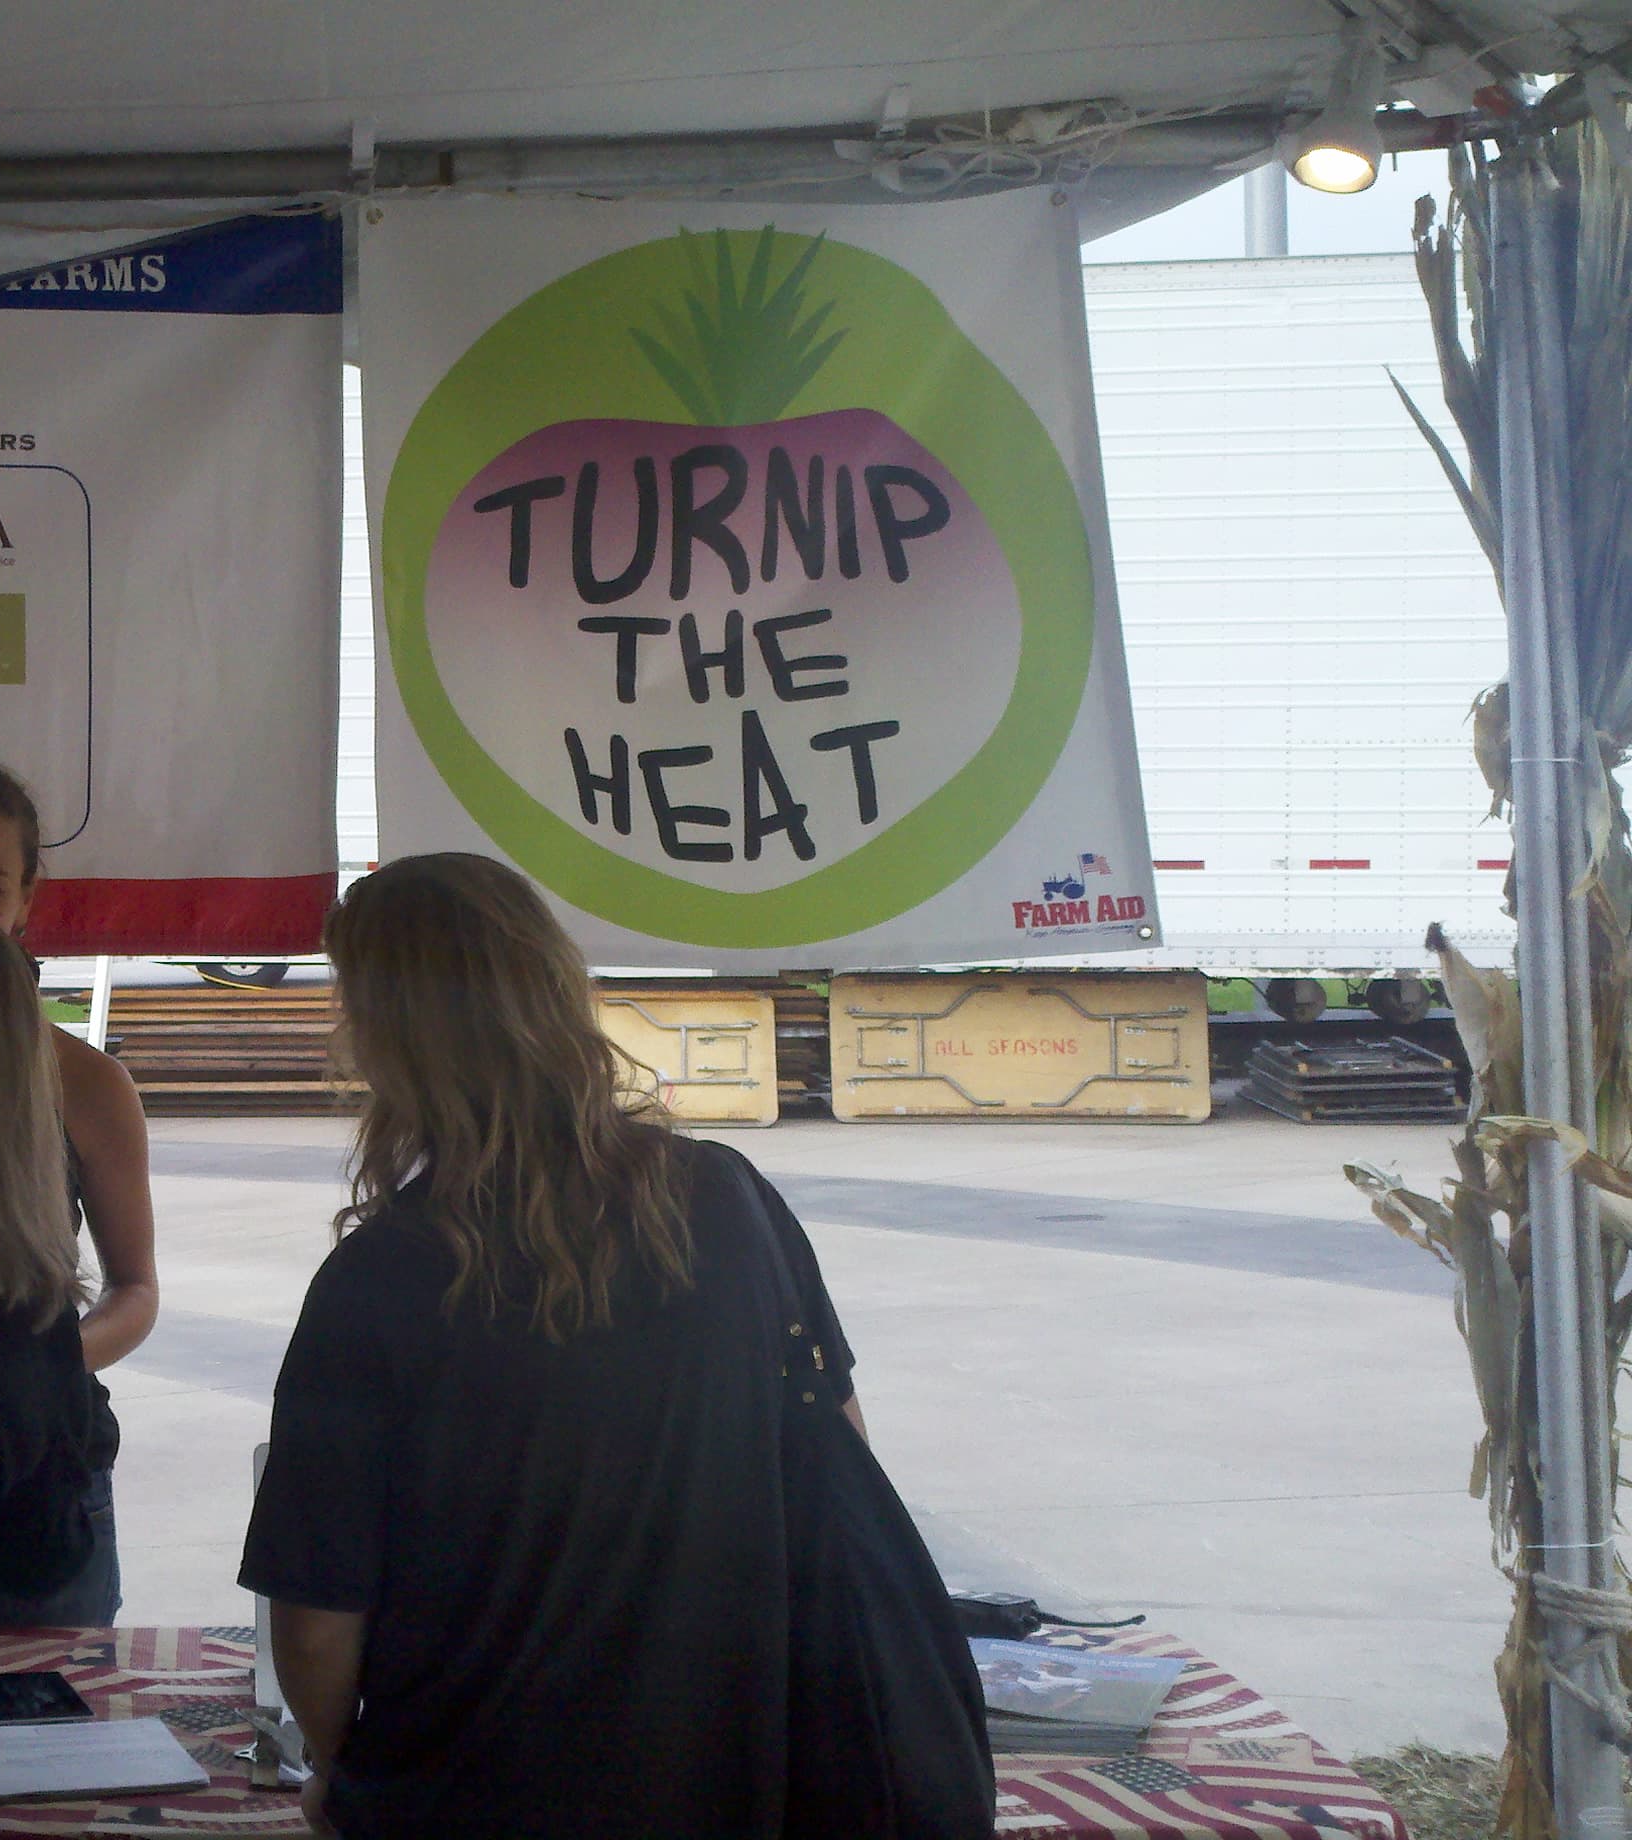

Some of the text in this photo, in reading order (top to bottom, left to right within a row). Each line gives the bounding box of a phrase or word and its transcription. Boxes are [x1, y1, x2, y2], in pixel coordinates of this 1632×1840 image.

[5, 253, 167, 293] ARMS
[473, 444, 951, 604] TURNIP
[577, 608, 850, 704] THE
[564, 709, 900, 864] HEAT
[1012, 894, 1146, 929] FARM AID
[935, 1038, 1079, 1057] ALL SEASONS
